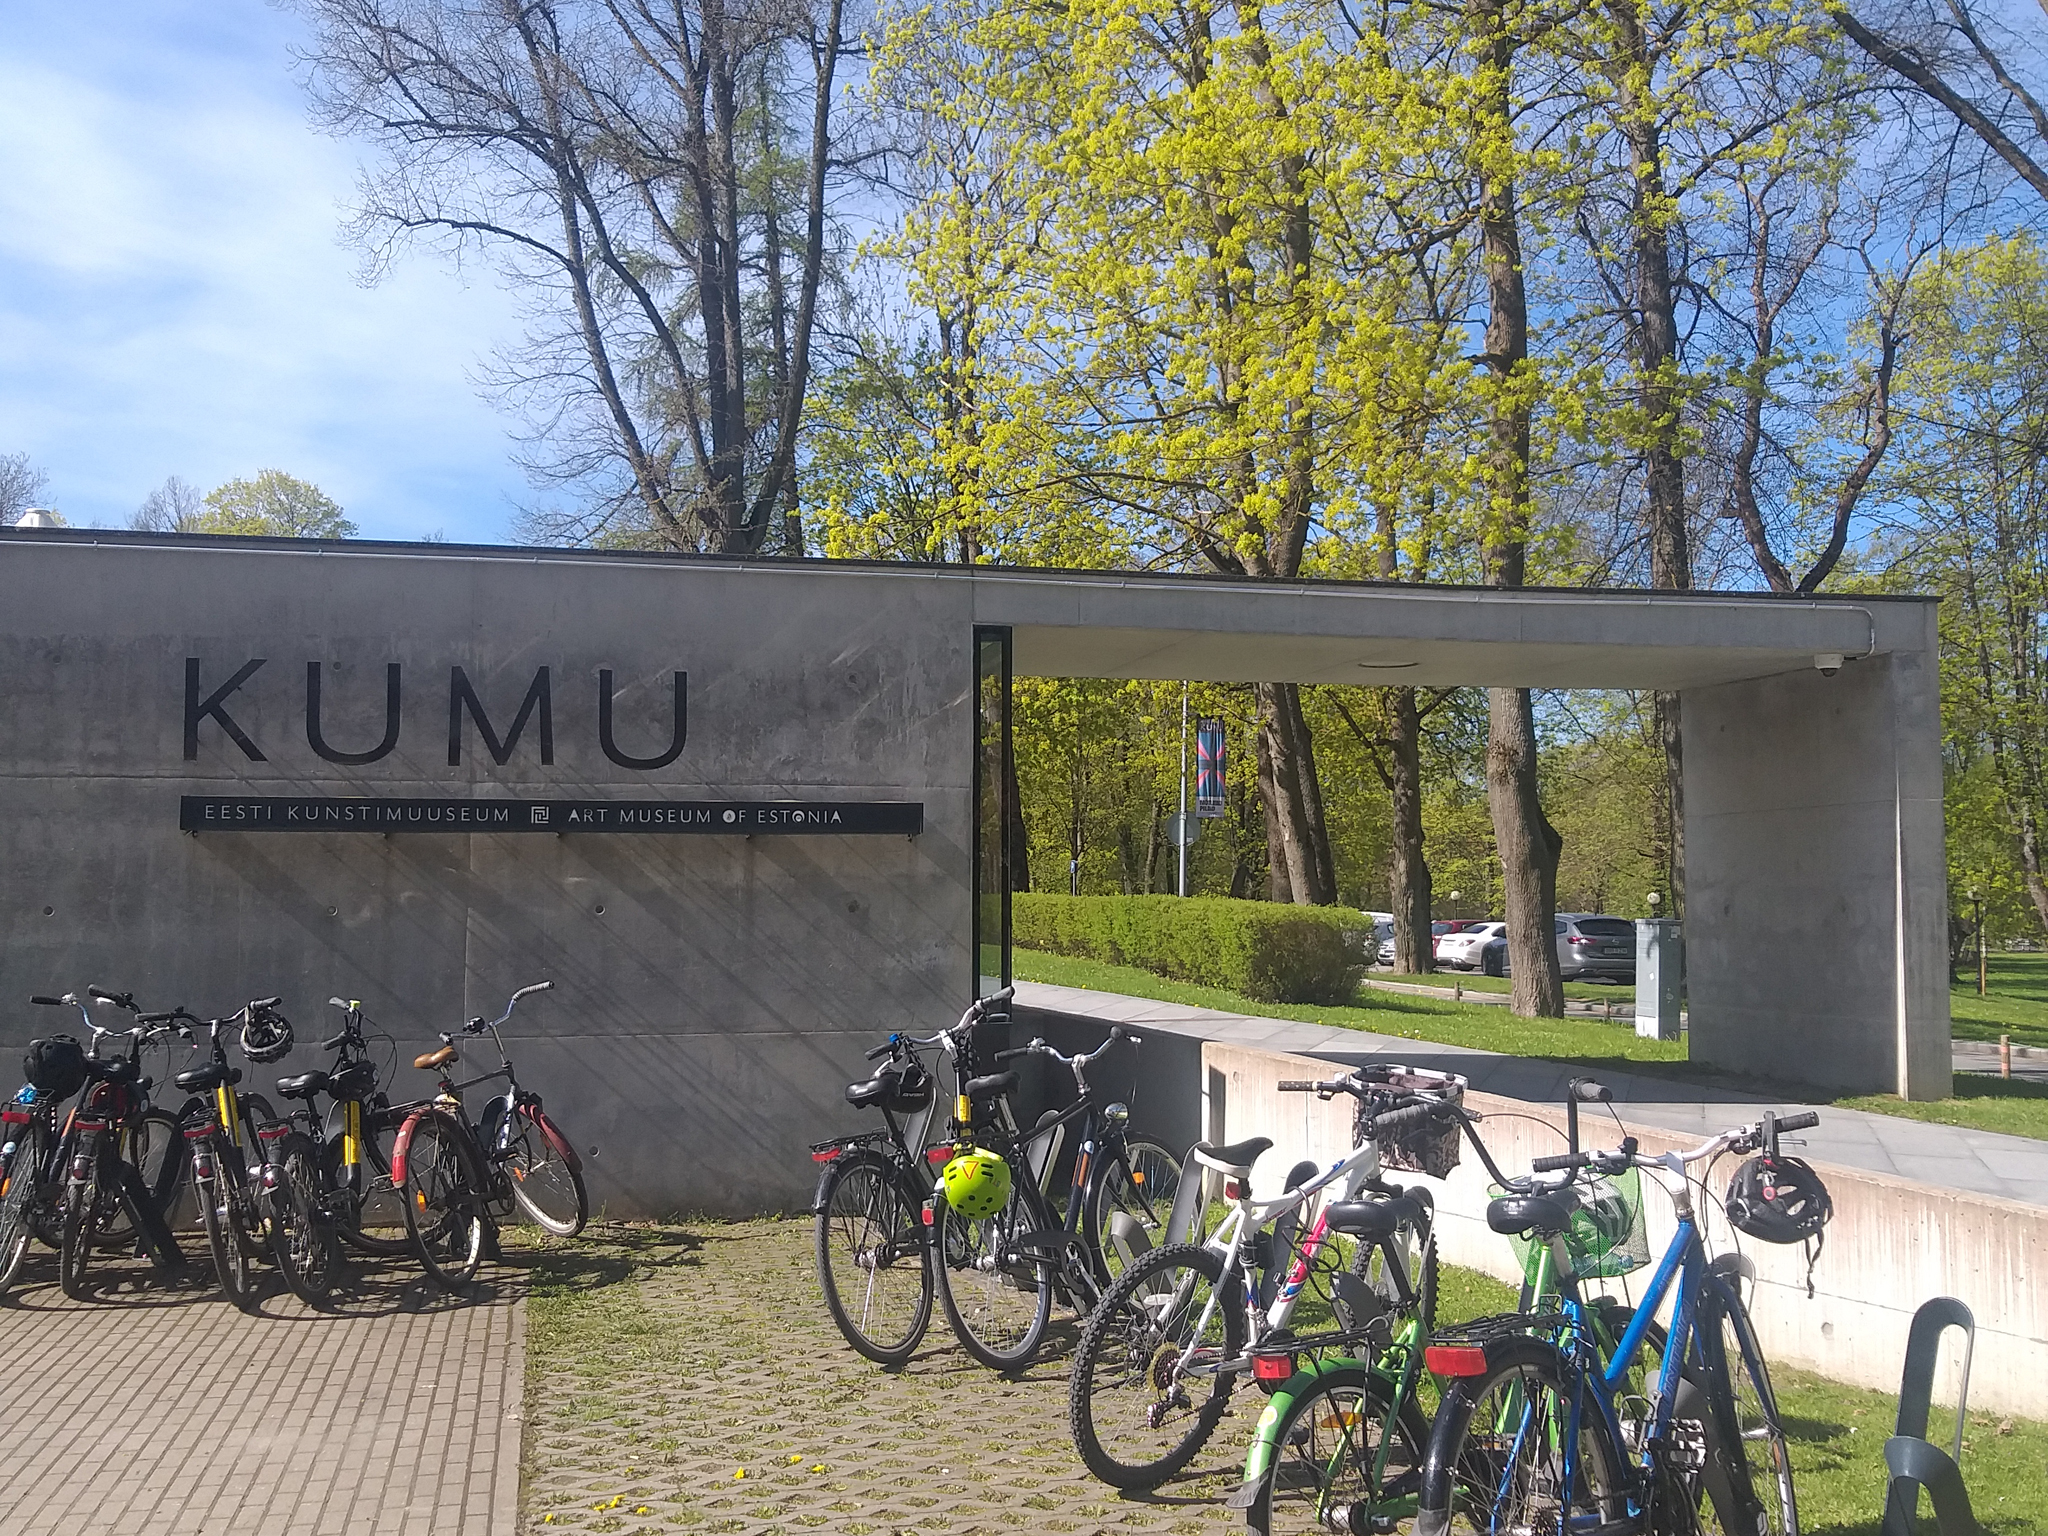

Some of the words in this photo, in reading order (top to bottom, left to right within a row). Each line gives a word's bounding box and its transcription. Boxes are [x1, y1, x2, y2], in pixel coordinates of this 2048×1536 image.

[183, 657, 688, 771] KUMU
[204, 804, 272, 820] EESTI
[288, 805, 510, 822] KUNSTIMUUSEUM
[568, 808, 608, 823] ART
[619, 808, 712, 824] MUSEUM
[722, 809, 747, 824] OF
[757, 809, 843, 825] ESTONIA
